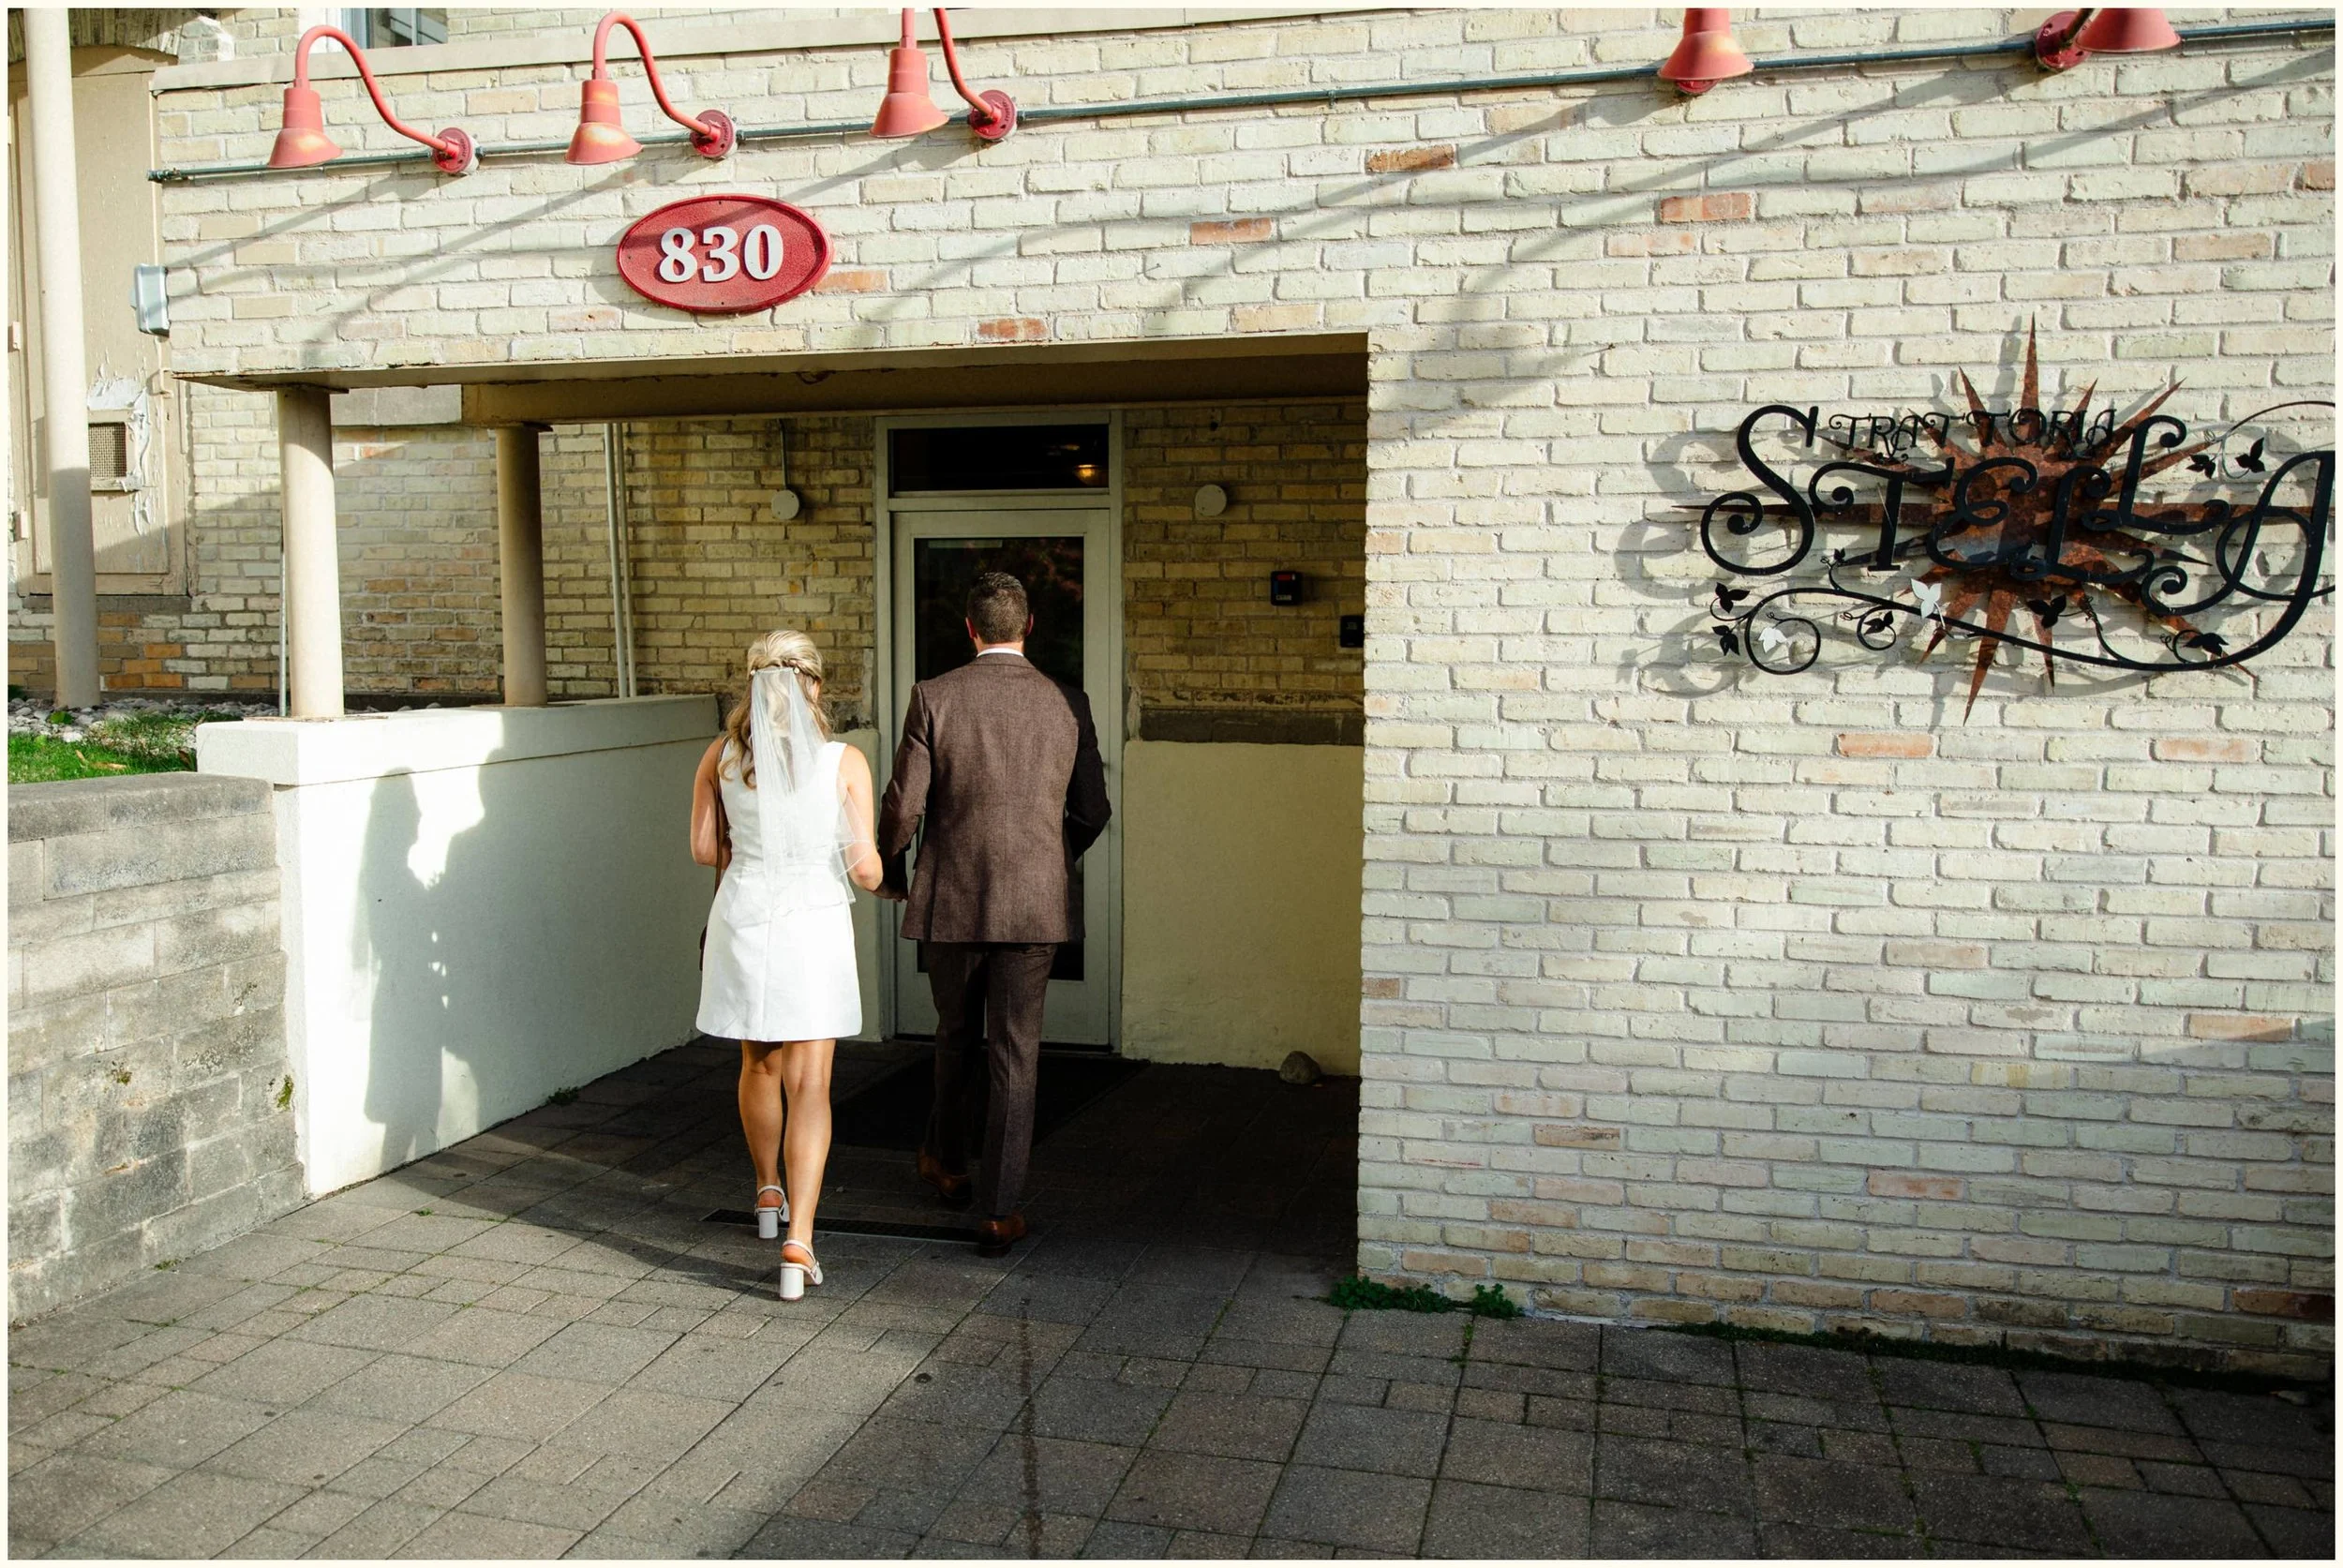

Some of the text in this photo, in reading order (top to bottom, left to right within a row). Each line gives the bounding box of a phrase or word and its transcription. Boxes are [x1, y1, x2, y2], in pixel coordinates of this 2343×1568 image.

[659, 224, 783, 283] 830
[1828, 408, 2117, 463] TRATTORIA
[1700, 404, 2335, 622] STELLA
